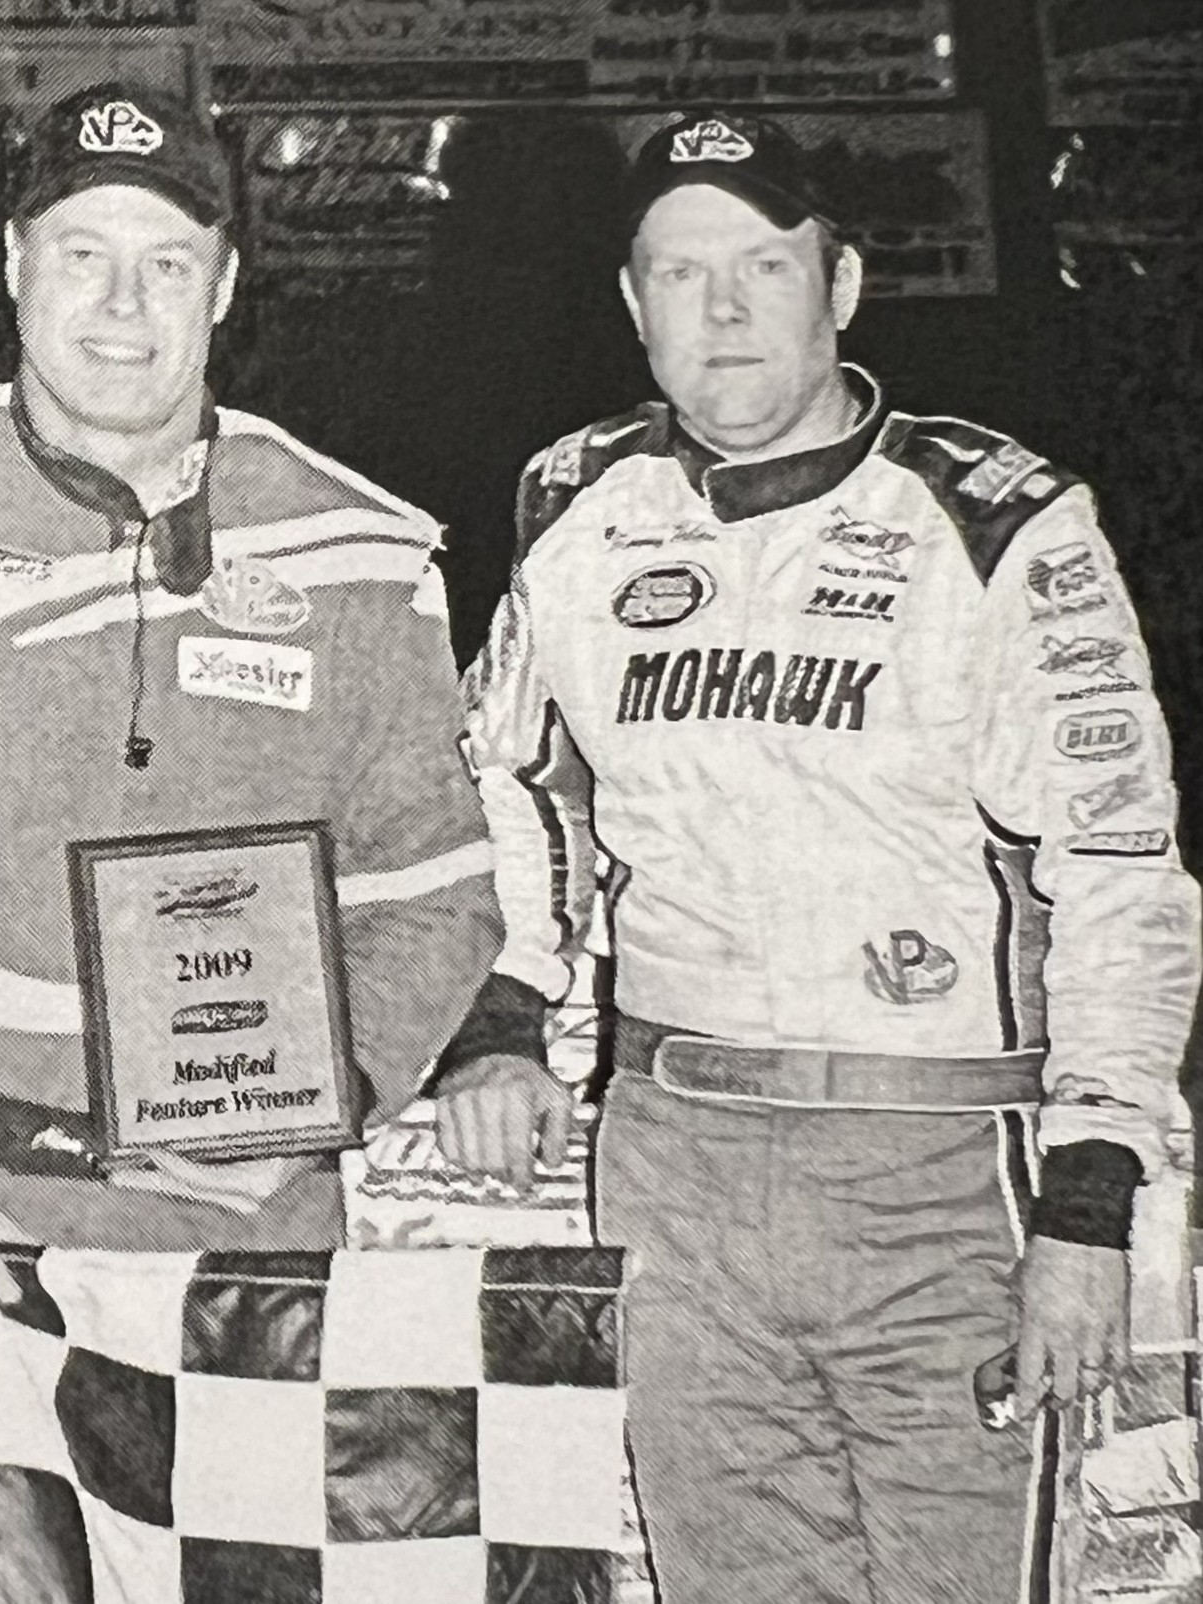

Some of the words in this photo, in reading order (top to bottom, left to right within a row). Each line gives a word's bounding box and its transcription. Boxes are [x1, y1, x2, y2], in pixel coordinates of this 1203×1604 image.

[615, 647, 883, 731] MOHAWK
[175, 948, 253, 982] 2009
[173, 1049, 277, 1085] Modified
[135, 1097, 228, 1123] Feature
[231, 1086, 321, 1113] Winner
